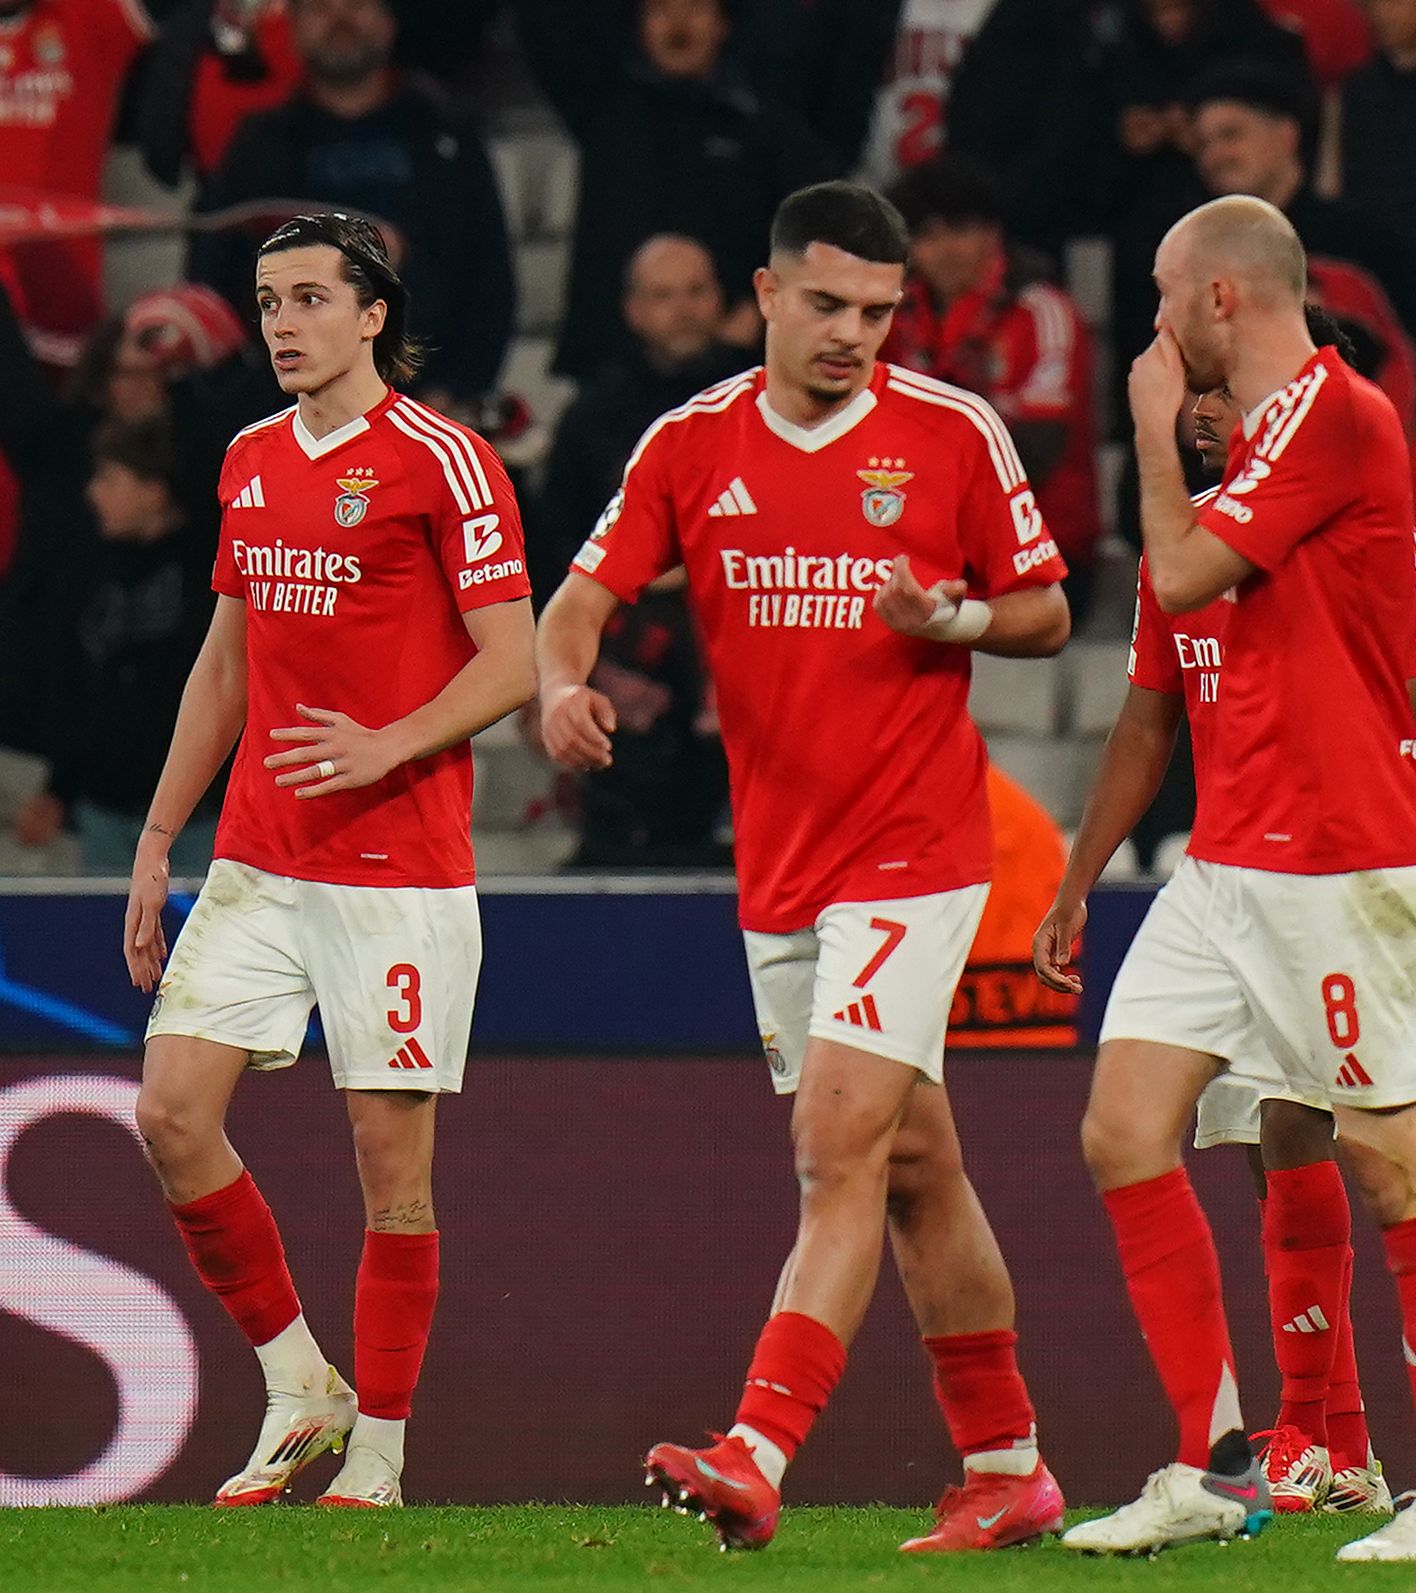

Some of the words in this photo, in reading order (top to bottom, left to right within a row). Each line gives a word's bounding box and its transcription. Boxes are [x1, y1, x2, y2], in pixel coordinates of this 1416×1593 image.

[232, 539, 362, 583] Emirates
[458, 558, 523, 590] Betano
[720, 546, 895, 592] Emirates
[249, 580, 270, 611] FLY
[272, 582, 339, 616] BETTER
[749, 594, 783, 628] FLY
[783, 594, 865, 629] BETTER
[852, 917, 907, 989] 7
[386, 962, 422, 1034] 3
[1321, 972, 1360, 1050] 8
